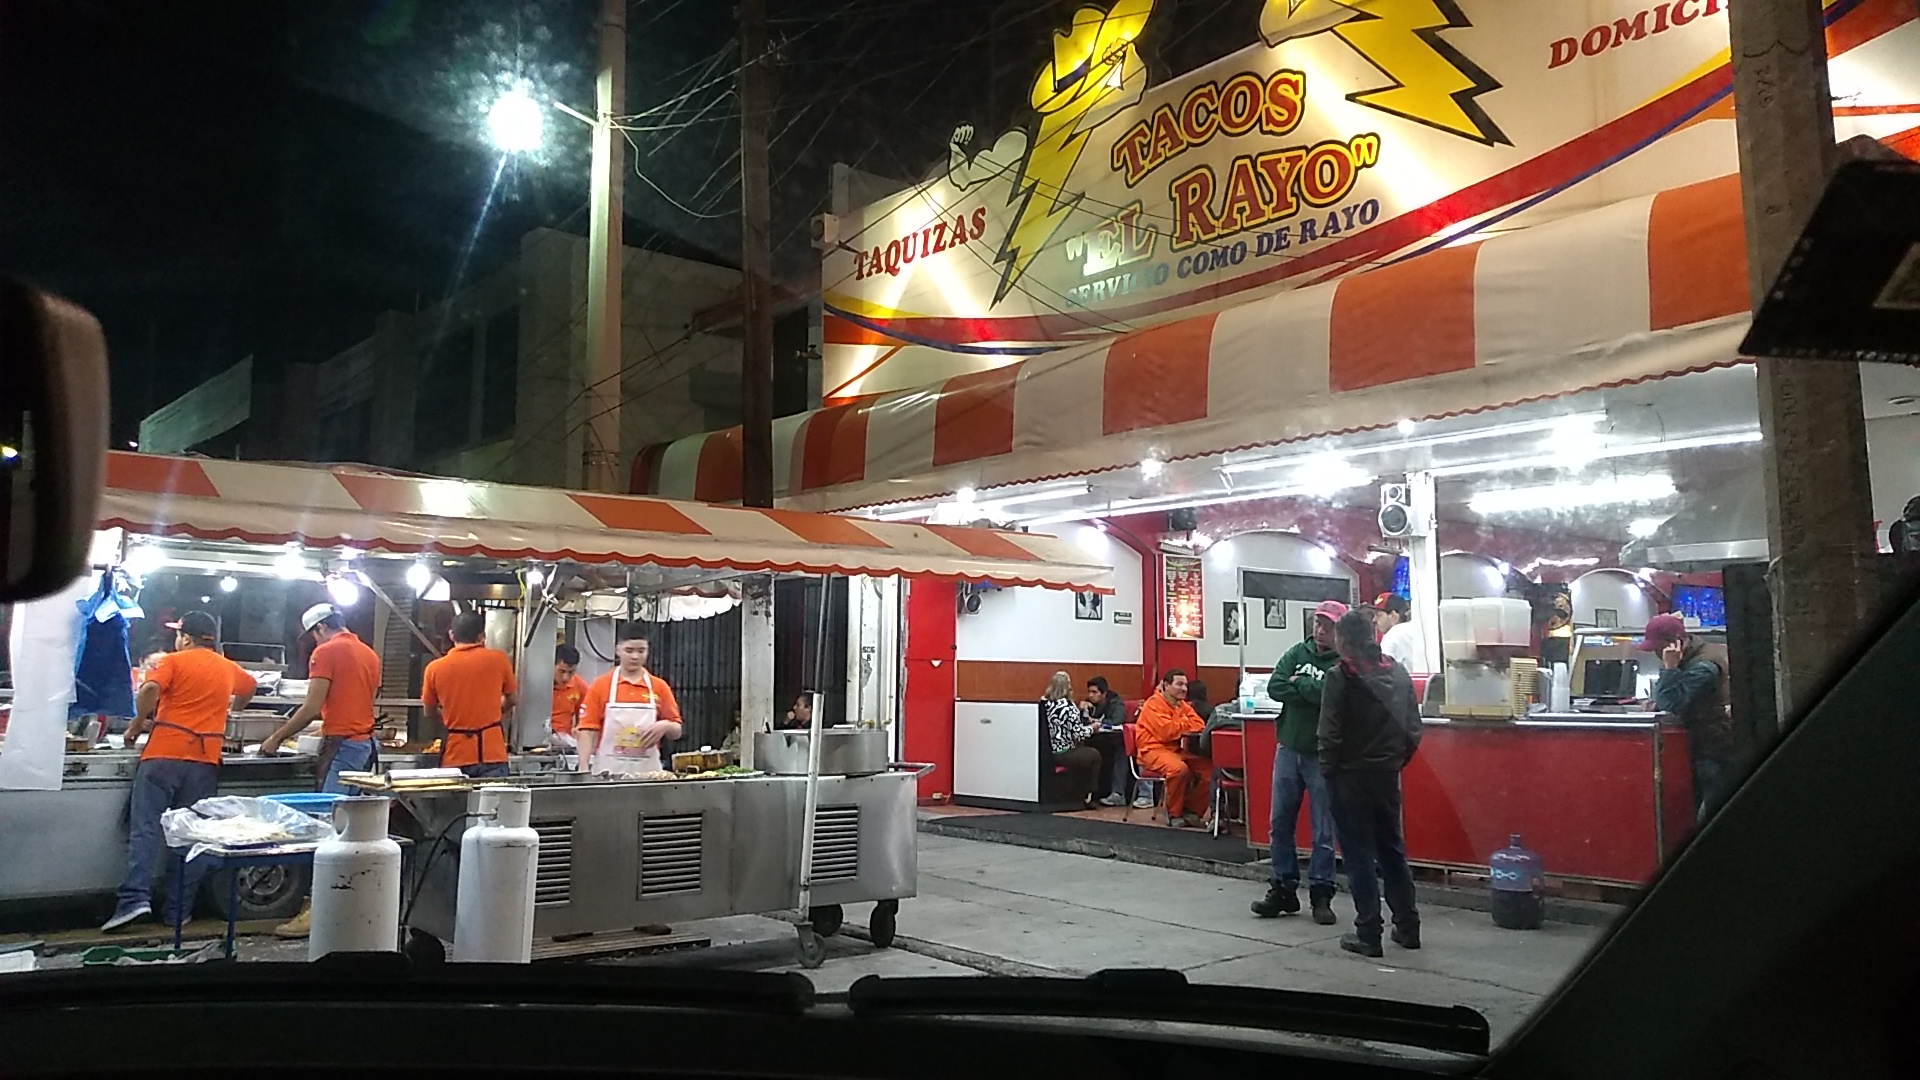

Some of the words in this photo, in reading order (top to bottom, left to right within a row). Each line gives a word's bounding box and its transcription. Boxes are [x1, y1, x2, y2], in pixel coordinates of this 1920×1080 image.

[1548, 0, 1729, 69] DOMICI
[1112, 70, 1305, 187] TACOS
[853, 206, 986, 280] TAQUIZAS
[1065, 263, 1169, 307] SERVICO
[1177, 241, 1247, 279] COMO
[1256, 226, 1291, 258] DE
[1299, 199, 1380, 245] RAYO
